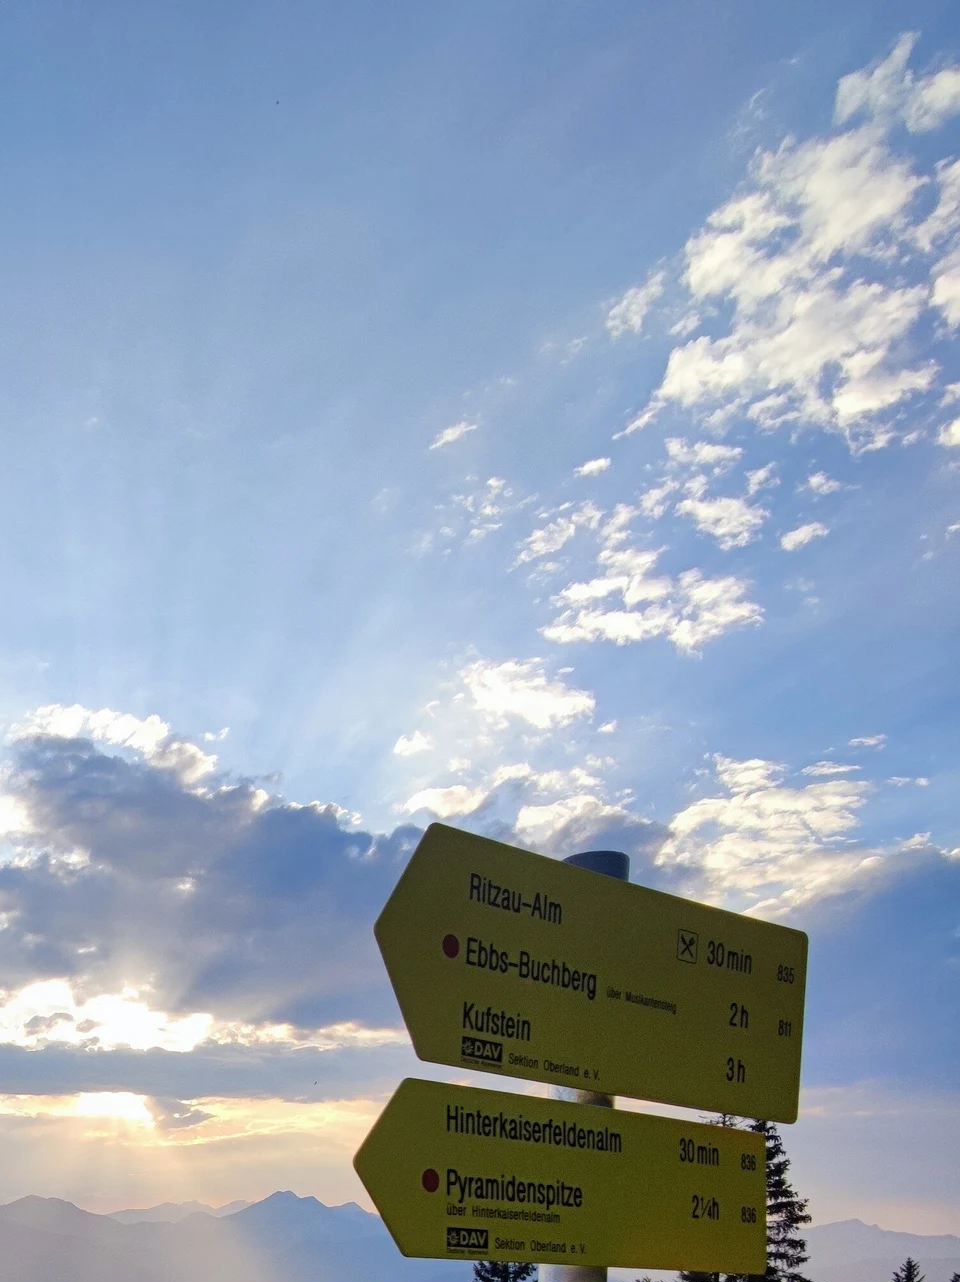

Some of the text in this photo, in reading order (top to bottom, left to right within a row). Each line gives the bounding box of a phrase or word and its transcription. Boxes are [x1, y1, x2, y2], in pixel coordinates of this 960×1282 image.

[469, 872, 563, 925] Ritzau-Alm
[466, 936, 597, 1000] Ebbs-Buchberg
[776, 963, 796, 985] 835
[462, 1001, 531, 1042] Kufstein
[777, 1018, 792, 1038] 811
[473, 1041, 502, 1060] DAV
[508, 1052, 539, 1069] Sektion
[543, 1059, 580, 1077] Oberland
[446, 1103, 623, 1154] Hinterkaiserfeldenalm
[741, 1153, 757, 1172] 836
[446, 1168, 583, 1212] Pyramidenspitze
[446, 1202, 561, 1224] über Hinterkaiserfeldenalm
[741, 1207, 757, 1225] 836
[459, 1230, 487, 1247] DAV
[494, 1237, 526, 1252] Sektion
[530, 1240, 566, 1254] Oberland
